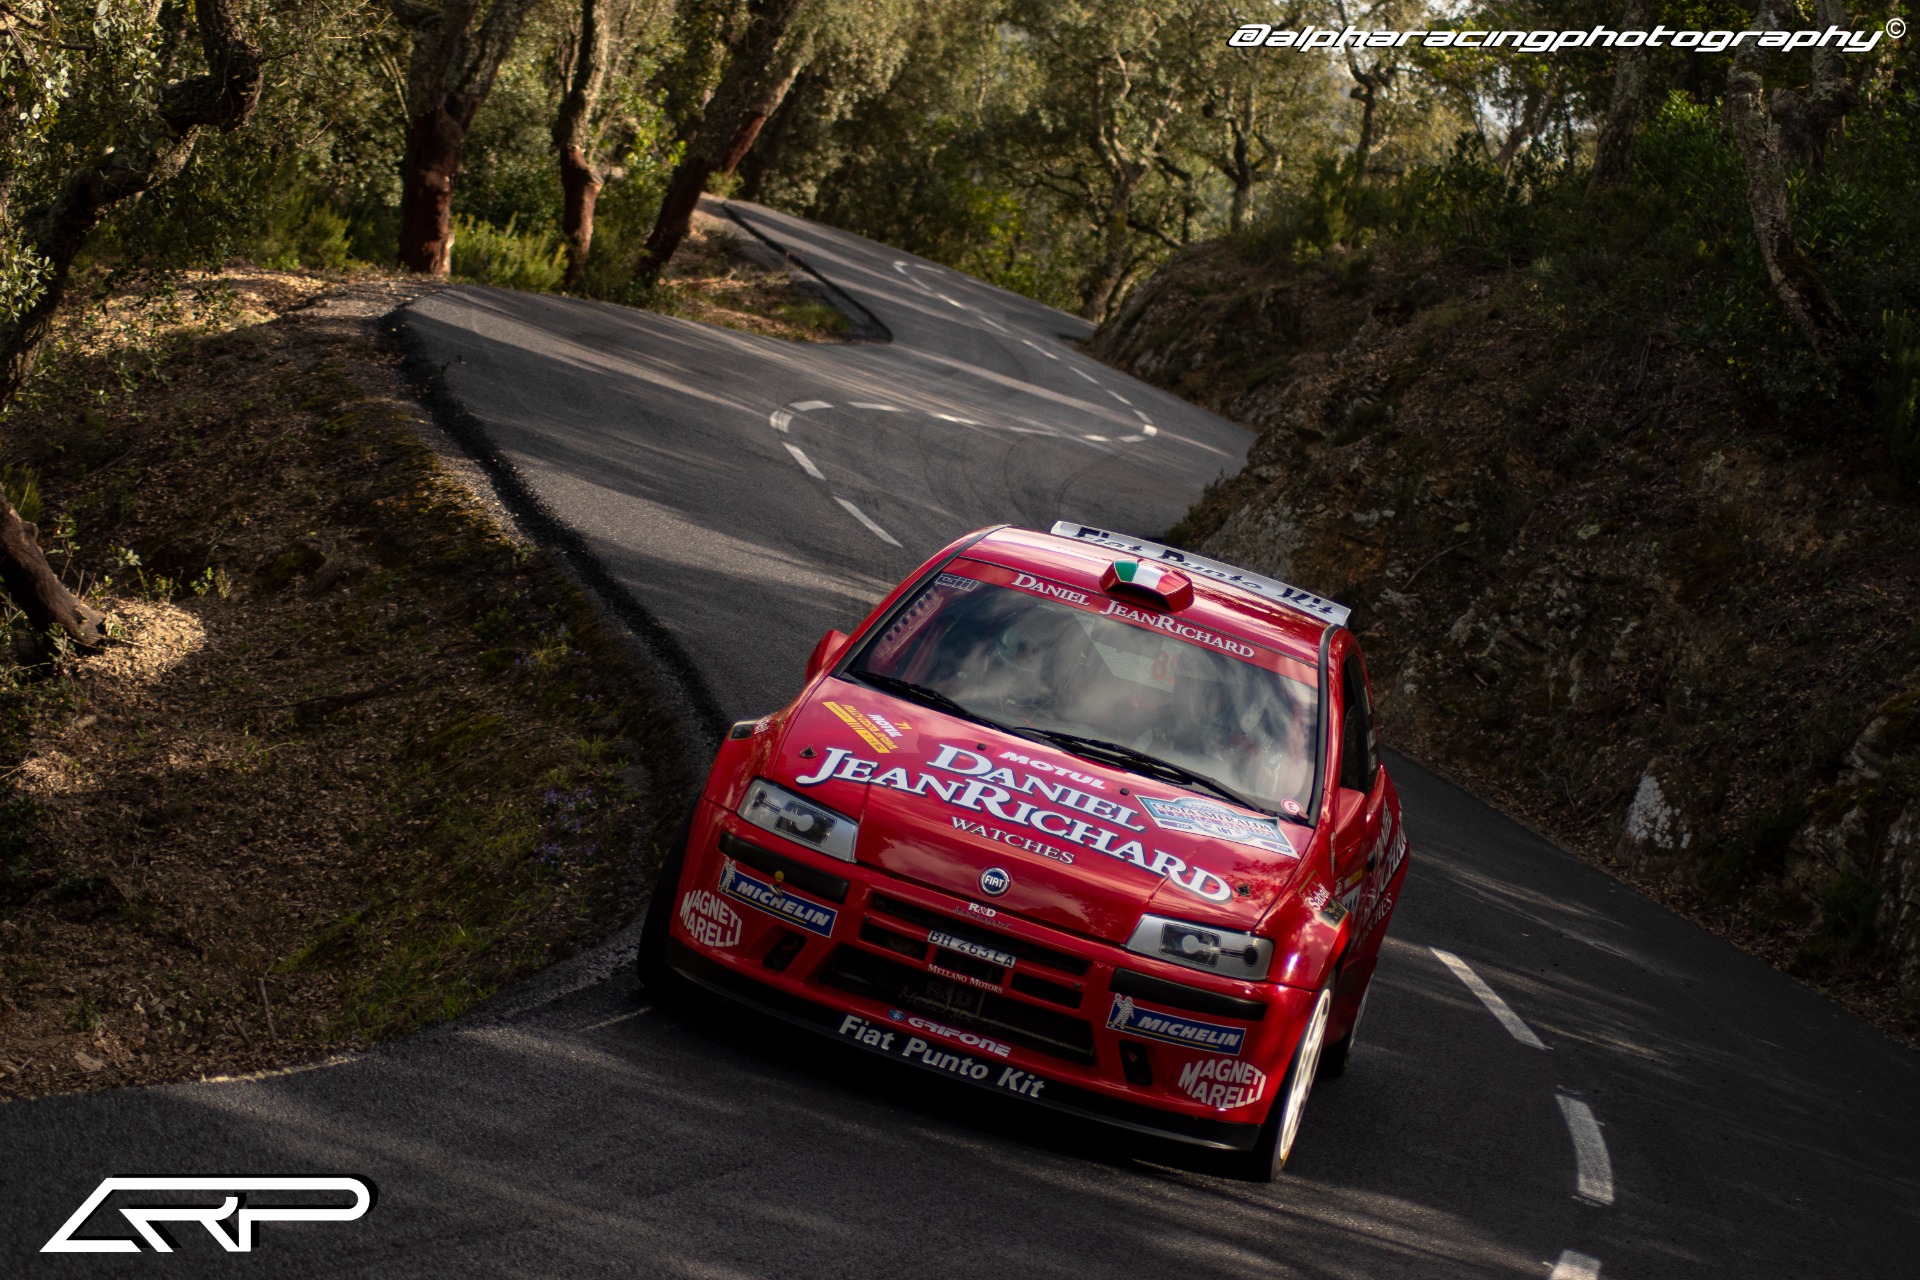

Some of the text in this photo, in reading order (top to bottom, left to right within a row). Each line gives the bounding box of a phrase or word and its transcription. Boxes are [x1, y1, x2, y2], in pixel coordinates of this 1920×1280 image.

[1011, 572, 1090, 606] DANIEL
[926, 743, 1146, 833] DANIEL
[998, 751, 1106, 790] MOTUL
[951, 816, 1075, 865] WATCHES
[984, 874, 1005, 888] FIAT
[736, 880, 831, 927] MICHELIN
[968, 902, 997, 918] R&D
[907, 1016, 1012, 1058] GRIFONE
[1137, 1015, 1240, 1047] MICHELIN
[838, 1014, 1045, 1098] Fiat Punto Kit
